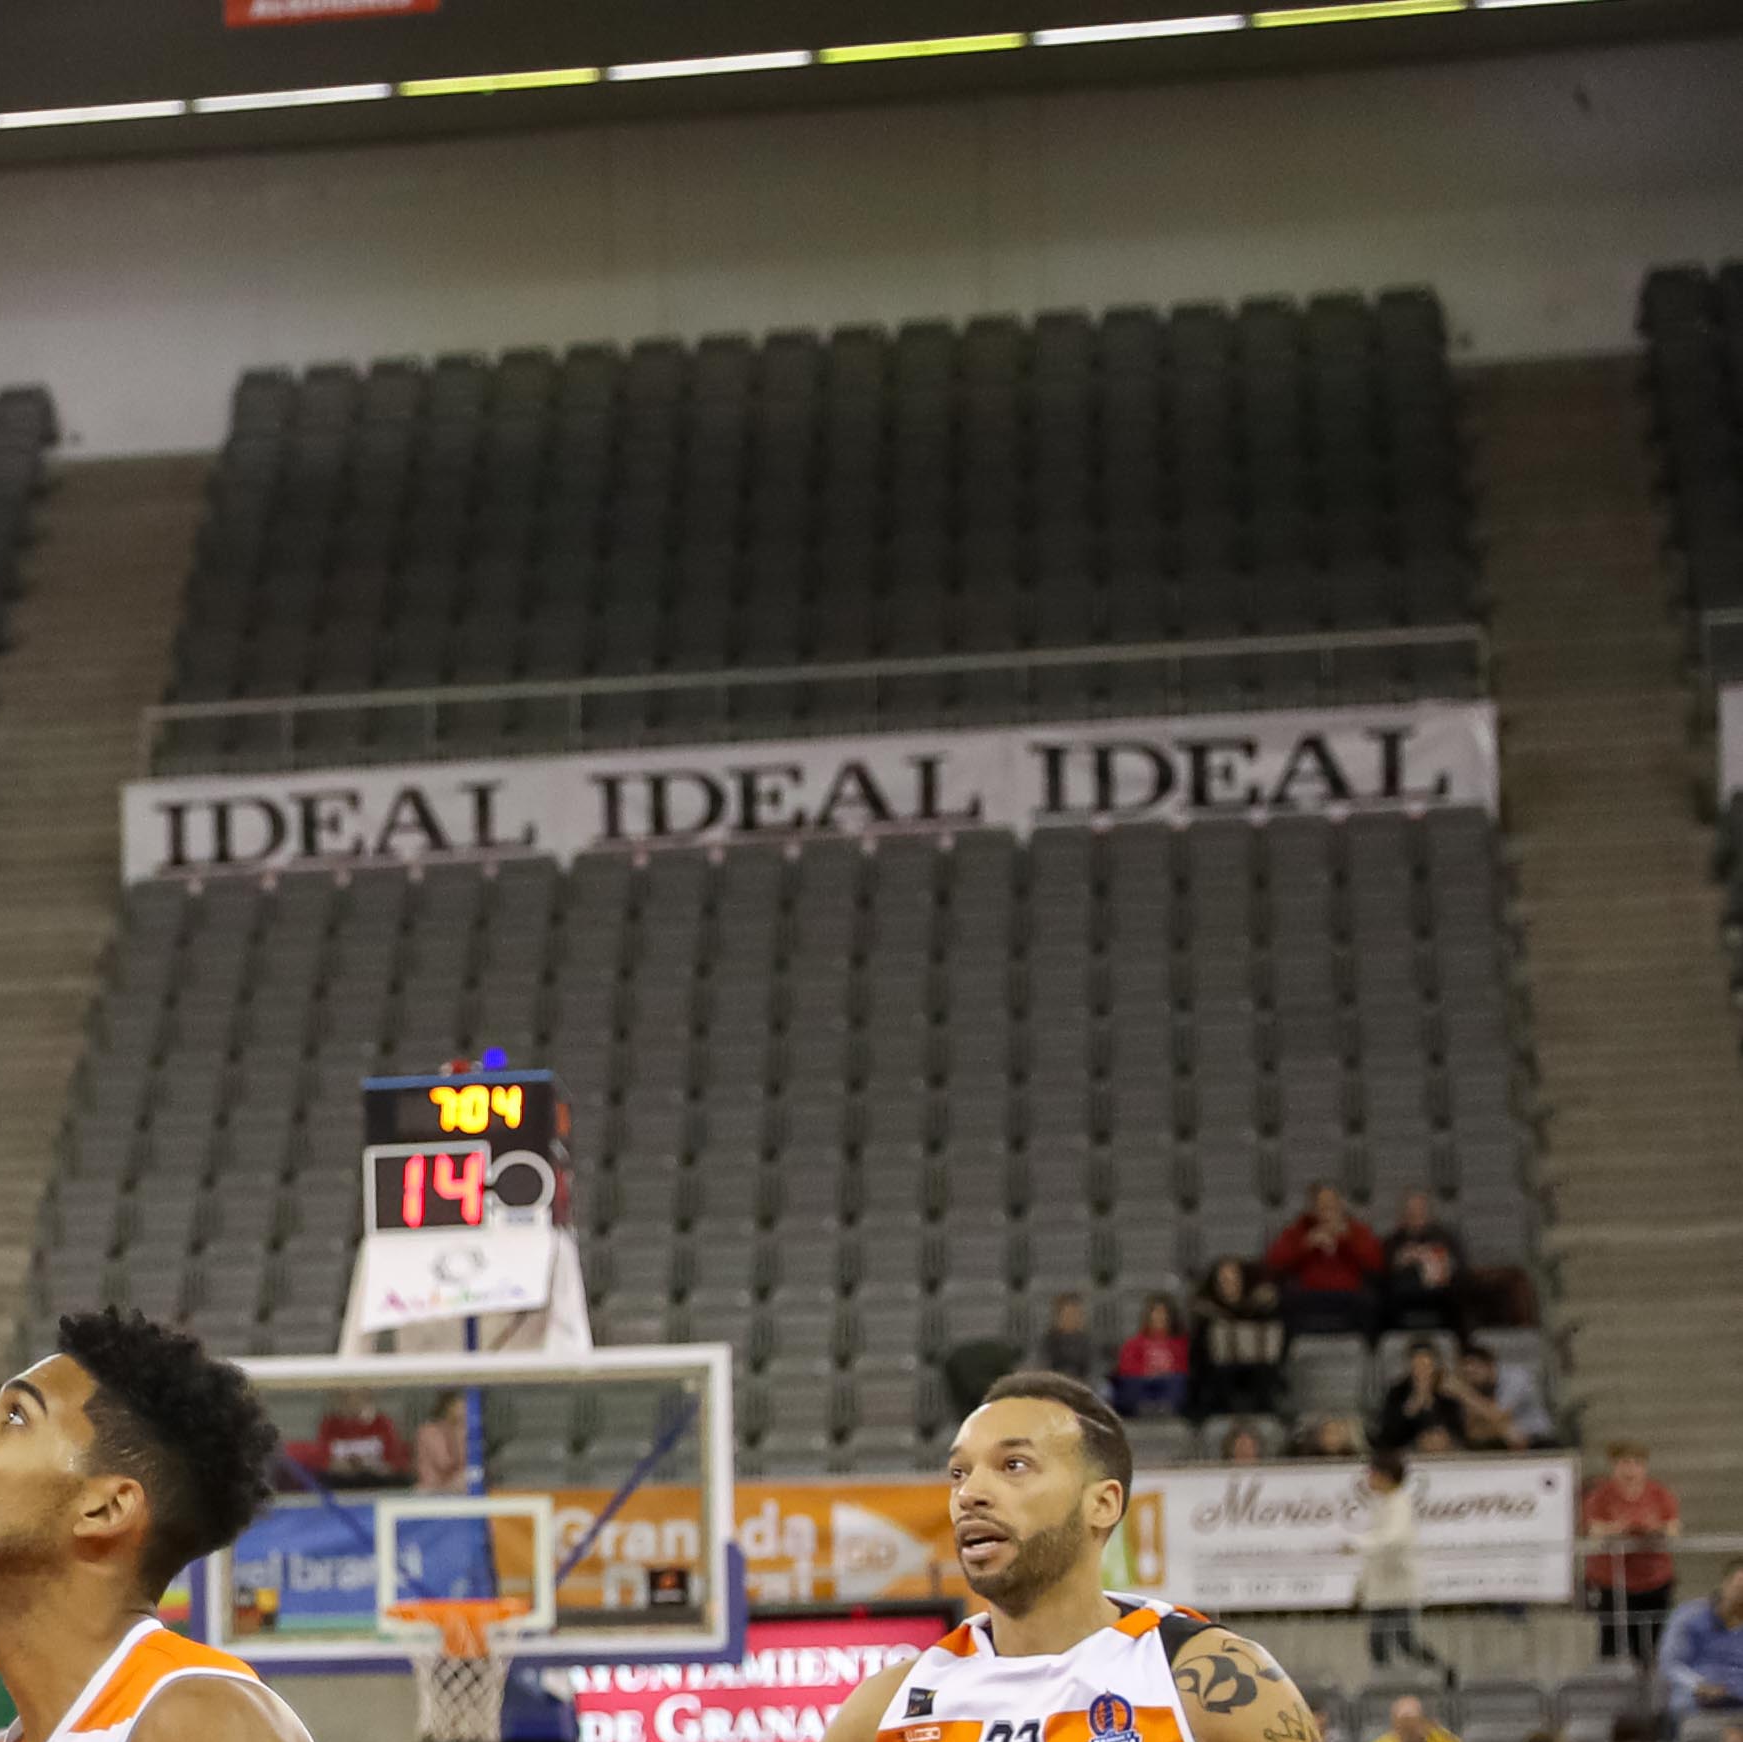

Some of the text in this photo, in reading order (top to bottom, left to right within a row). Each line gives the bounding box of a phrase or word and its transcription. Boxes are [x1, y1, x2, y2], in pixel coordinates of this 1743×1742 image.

[157, 724, 1449, 871] IDEAL IDEAL IDEAL
[402, 1152, 486, 1229] 14
